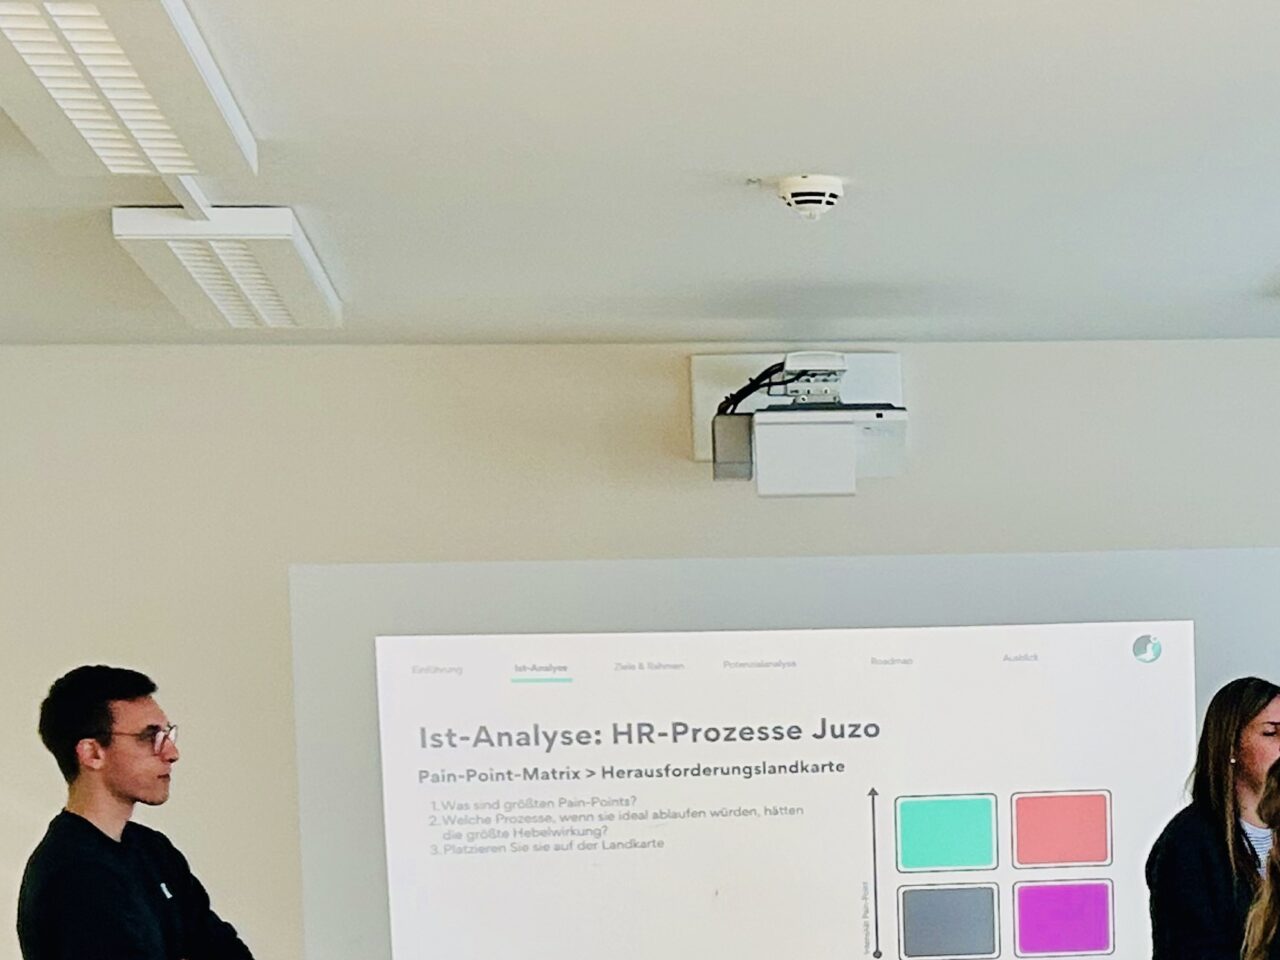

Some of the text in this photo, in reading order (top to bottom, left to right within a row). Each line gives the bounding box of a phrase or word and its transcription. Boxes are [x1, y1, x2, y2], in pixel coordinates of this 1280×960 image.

[514, 663, 568, 674] Ist-Analyse
[420, 717, 881, 753] Ist-Analyse: HR-Prozesse Juzo
[418, 765, 581, 784] Pain-Point-Matrix
[601, 759, 845, 779] Herausforderungslandkarte
[441, 799, 470, 811] Was
[473, 799, 500, 811] sind
[503, 797, 554, 812] größten
[558, 794, 638, 808] Pain-Points?
[442, 813, 492, 826] Welche
[559, 813, 594, 823] wenn
[597, 811, 616, 822] sie
[618, 808, 649, 821] ideal
[652, 807, 707, 820] ablaufen
[709, 806, 761, 818] würden,
[764, 804, 805, 817] hätten
[442, 825, 608, 842] die größte Hebelwirkung?
[444, 843, 506, 855] Platzieren
[510, 841, 529, 852] Sie
[532, 842, 550, 852] sie
[553, 840, 574, 851] auf
[577, 839, 598, 851] der
[601, 838, 665, 850] Landkarte
